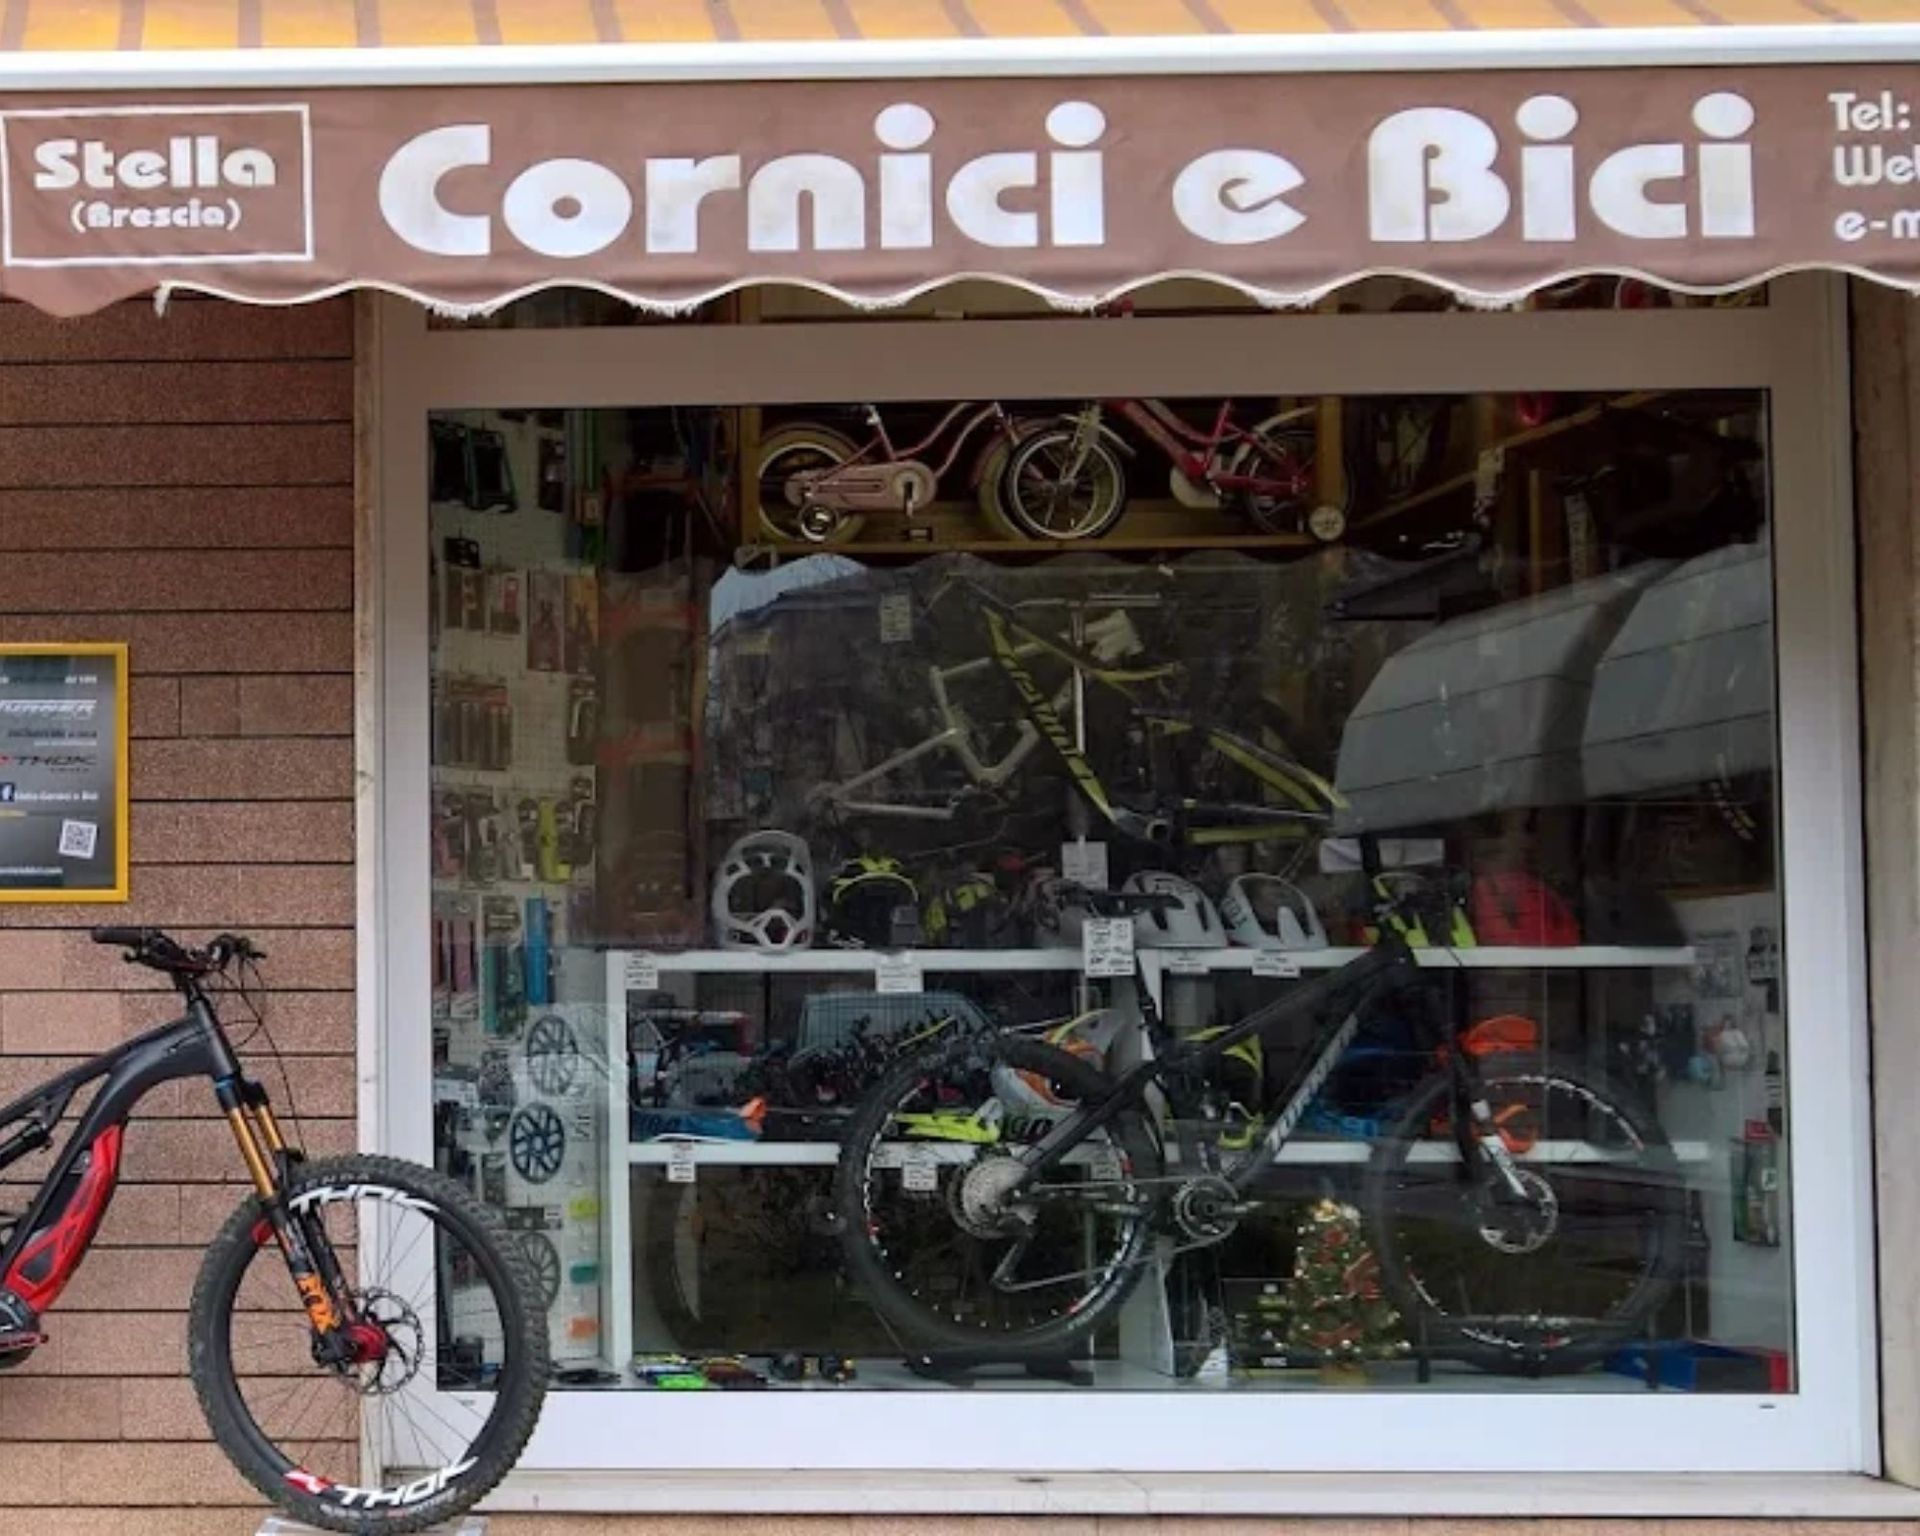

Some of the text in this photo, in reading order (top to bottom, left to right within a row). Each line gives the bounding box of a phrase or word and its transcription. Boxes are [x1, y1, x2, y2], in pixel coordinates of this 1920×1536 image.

[1828, 90, 1911, 132] Tel:
[33, 136, 276, 191] Stella
[377, 92, 1755, 259] Cornici e Bici
[1834, 143, 1920, 186] We
[71, 198, 242, 231] (Brescia)
[288, 1184, 441, 1215] THOK
[333, 1456, 480, 1508] THOK
